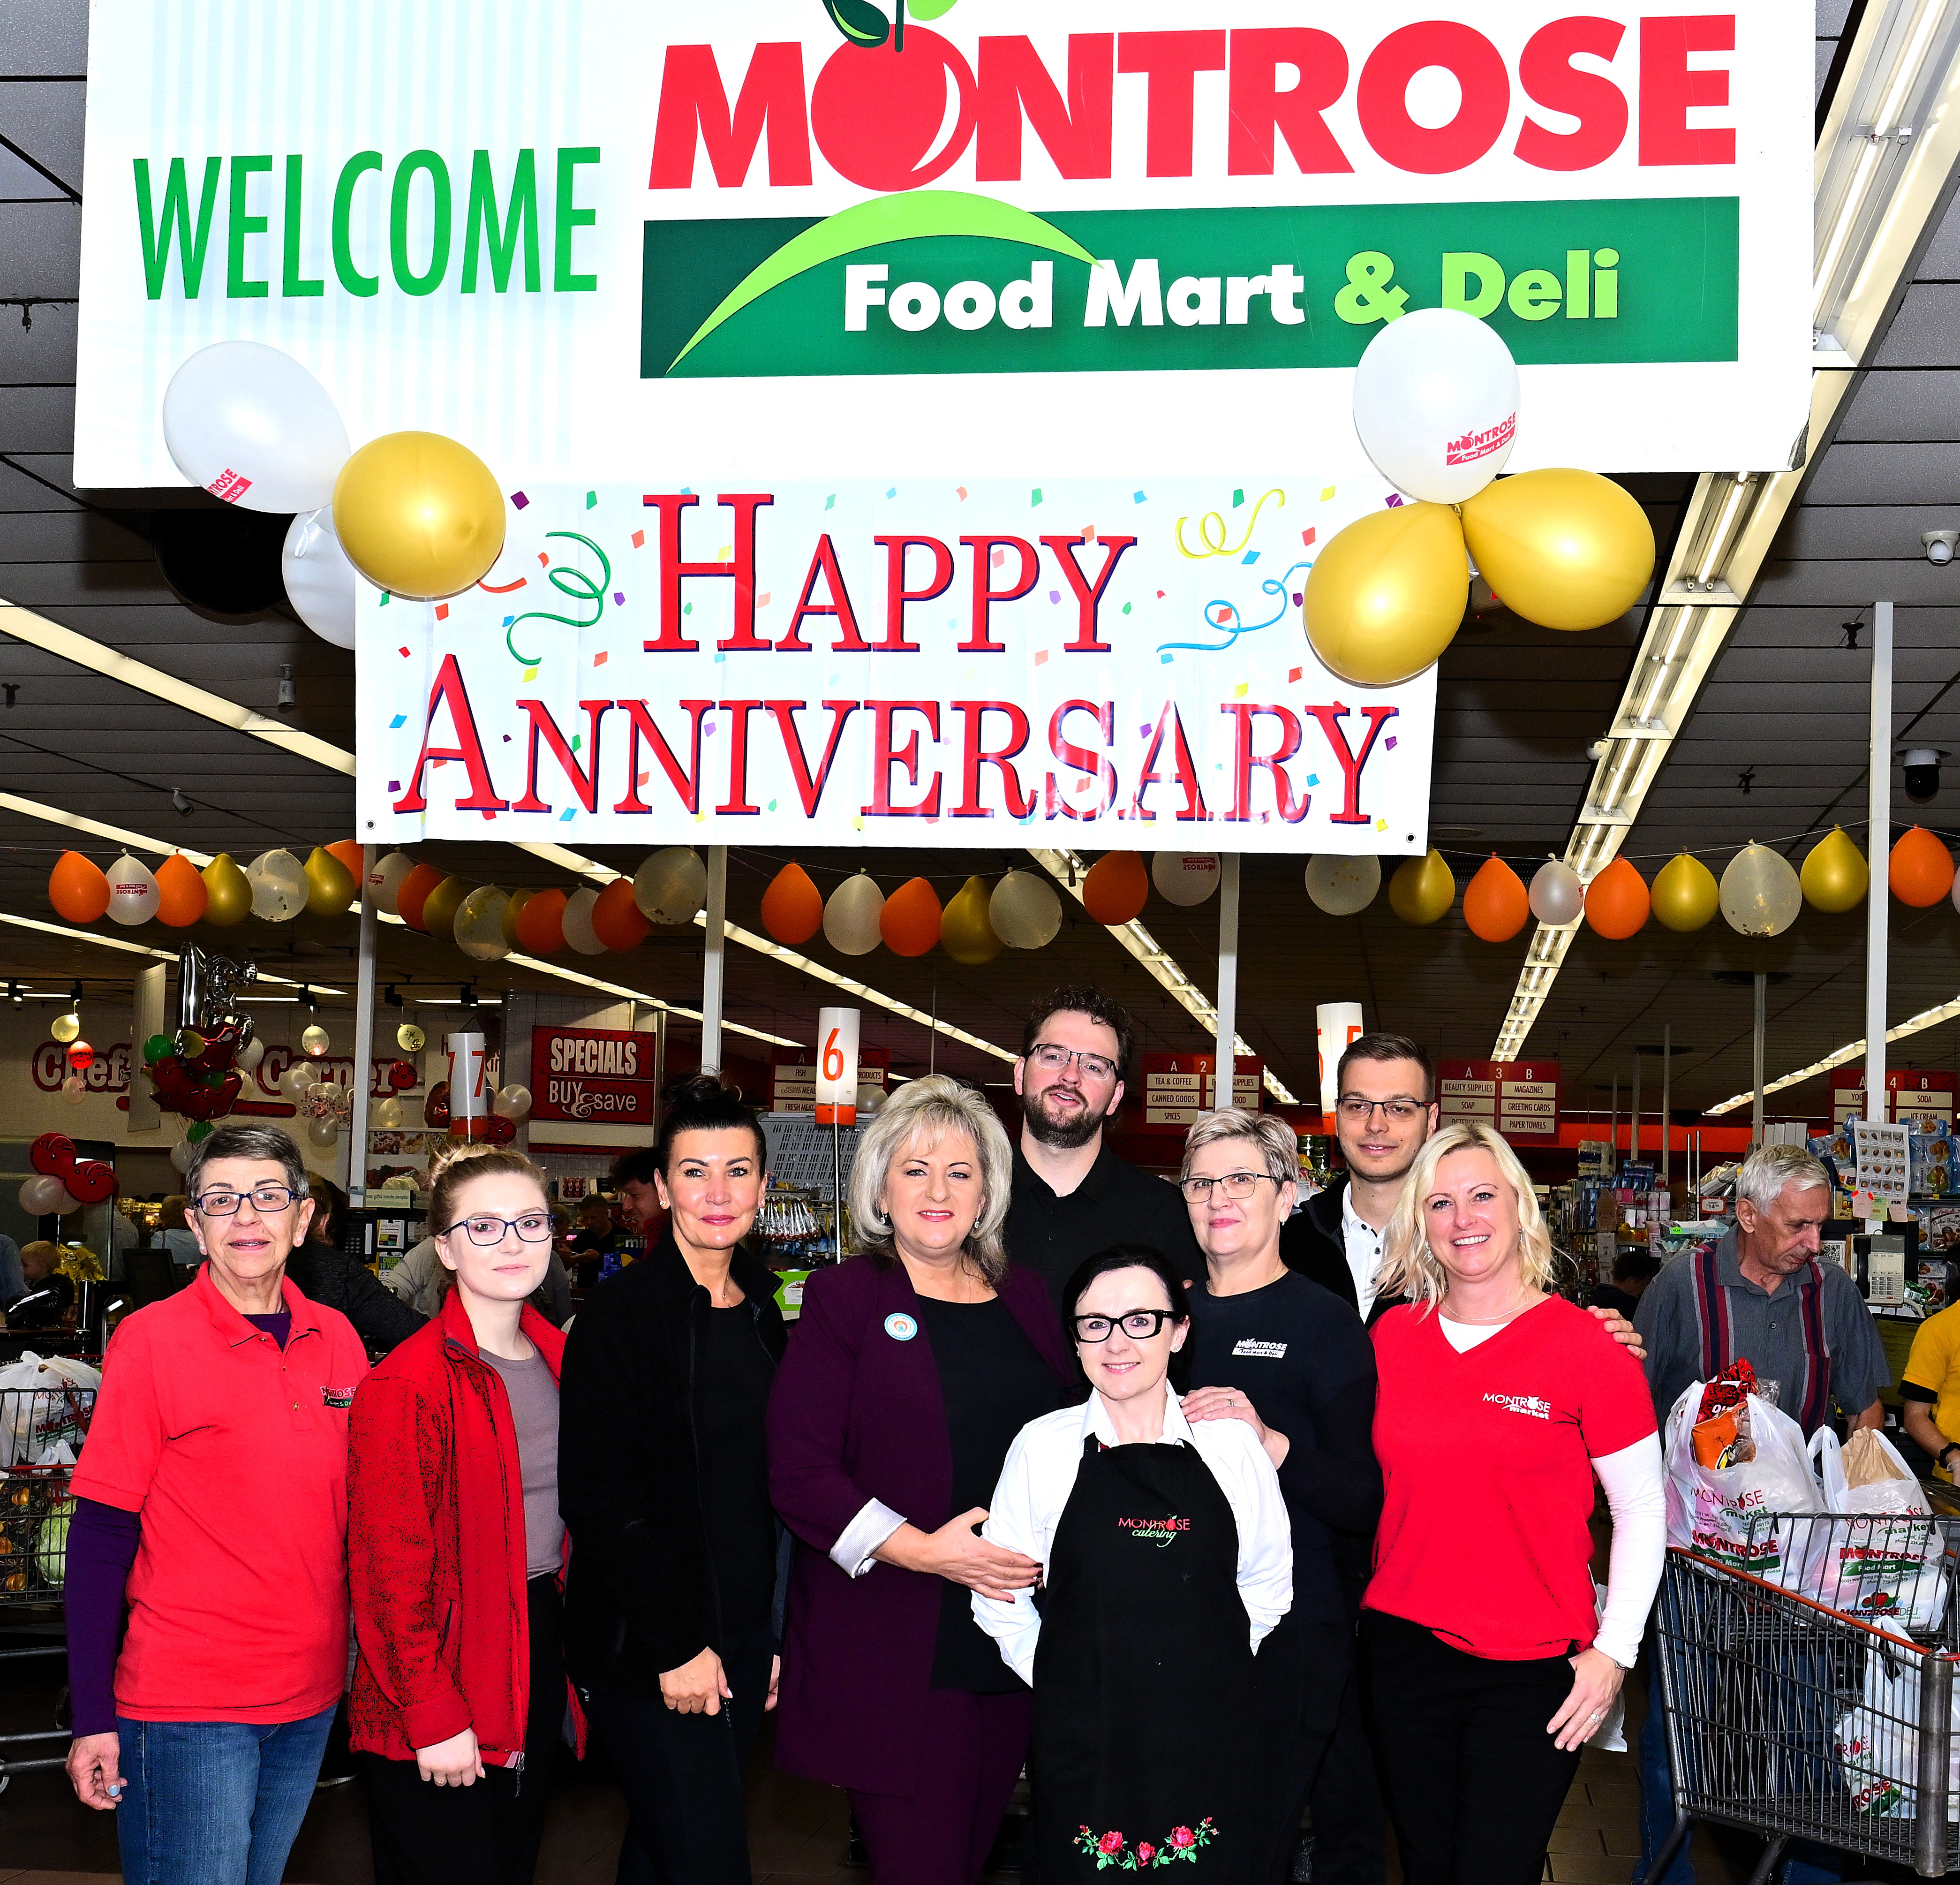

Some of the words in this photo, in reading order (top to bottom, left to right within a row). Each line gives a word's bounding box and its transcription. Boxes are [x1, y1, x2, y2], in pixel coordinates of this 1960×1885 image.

[648, 14, 1736, 192] MONTROSE
[133, 146, 601, 300] WELCOME
[844, 261, 1053, 332] Food
[1084, 258, 1305, 328] Mart
[1334, 250, 1410, 325] &
[1440, 247, 1620, 320] Deli
[1447, 411, 1516, 453] MONTROSE
[1462, 452, 1478, 462] Food
[1480, 446, 1495, 455] Mart
[1501, 433, 1510, 446] Deli
[642, 493, 1137, 652] HAPPY
[394, 653, 1399, 825] ANNIVERSARY
[550, 1037, 637, 1075] SPECIALS
[799, 1052, 805, 1064] A
[823, 1028, 844, 1081] 6
[472, 1051, 485, 1098] 7
[1170, 1061, 1178, 1072] A
[1200, 1061, 1206, 1073] 2
[1465, 1067, 1472, 1078] A
[1496, 1067, 1502, 1079] 3
[1526, 1068, 1532, 1080] B
[549, 1080, 583, 1104] BUY
[1445, 1083, 1466, 1091] BEAUTY
[1467, 1084, 1493, 1092] SUPPLIES
[1514, 1085, 1544, 1094] MAGAZINES
[1859, 1076, 1865, 1088] A
[1890, 1077, 1897, 1088] 4
[1922, 1078, 1928, 1089] B
[562, 1093, 595, 1118] &
[594, 1093, 636, 1111] save
[1176, 1095, 1195, 1103] GOODS
[1508, 1103, 1532, 1111] GREETING
[1235, 1339, 1288, 1351] MONTROSE
[1482, 1393, 1551, 1413] MONTROSE
[1509, 1407, 1549, 1420] market
[1118, 1515, 1191, 1531] MONTROSE
[1726, 1506, 1769, 1520] market
[1132, 1523, 1177, 1547] catering
[1692, 1529, 1779, 1558] MONTROSE
